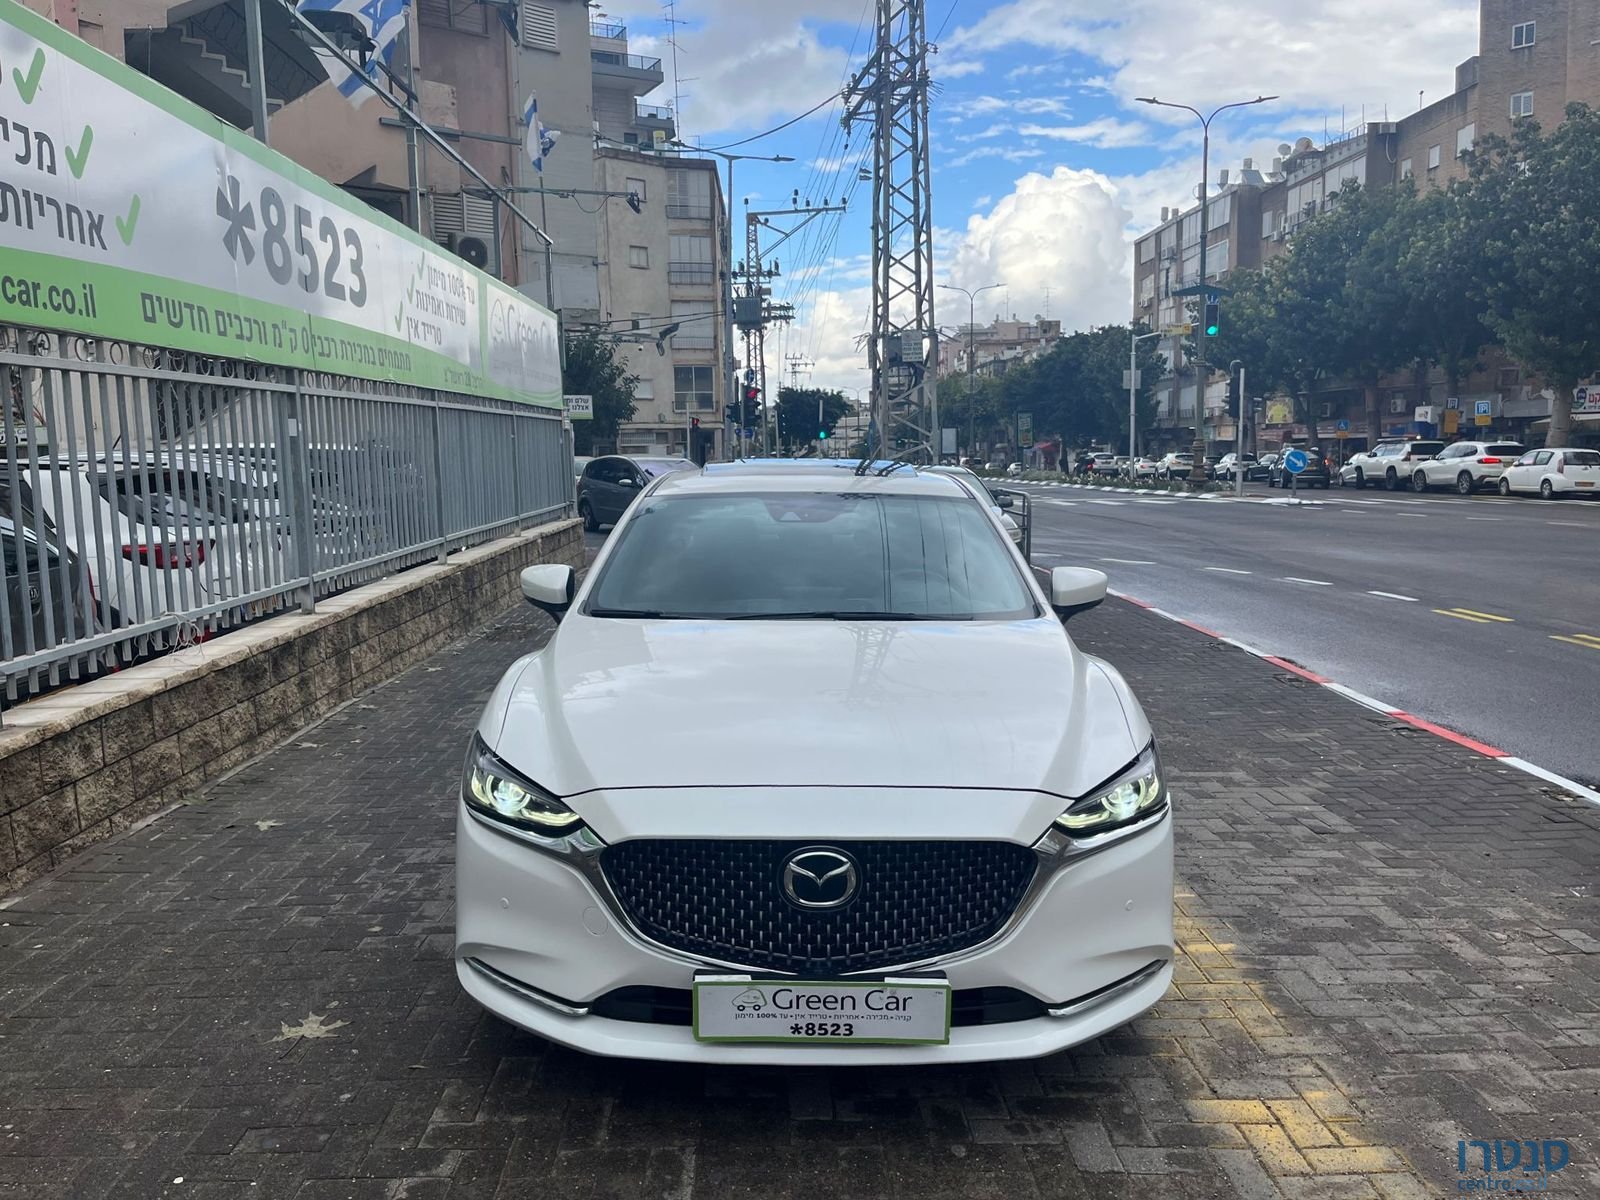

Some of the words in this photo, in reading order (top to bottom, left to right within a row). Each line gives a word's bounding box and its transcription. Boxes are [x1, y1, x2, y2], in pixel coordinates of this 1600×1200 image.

[0, 181, 108, 250] אחריות
[427, 265, 447, 290] מימון
[140, 292, 210, 334] חדשים
[416, 289, 445, 318] ואמינות
[445, 302, 466, 326] שירות
[214, 309, 268, 345] ורכבים
[406, 316, 420, 343] אין
[421, 321, 442, 345] טרייד
[340, 339, 378, 365] במכירת
[772, 988, 856, 1011] Green
[864, 989, 913, 1012] Car
[794, 1013, 806, 1021] אין
[866, 1013, 889, 1021] מכירה
[895, 1014, 912, 1022] קניה
